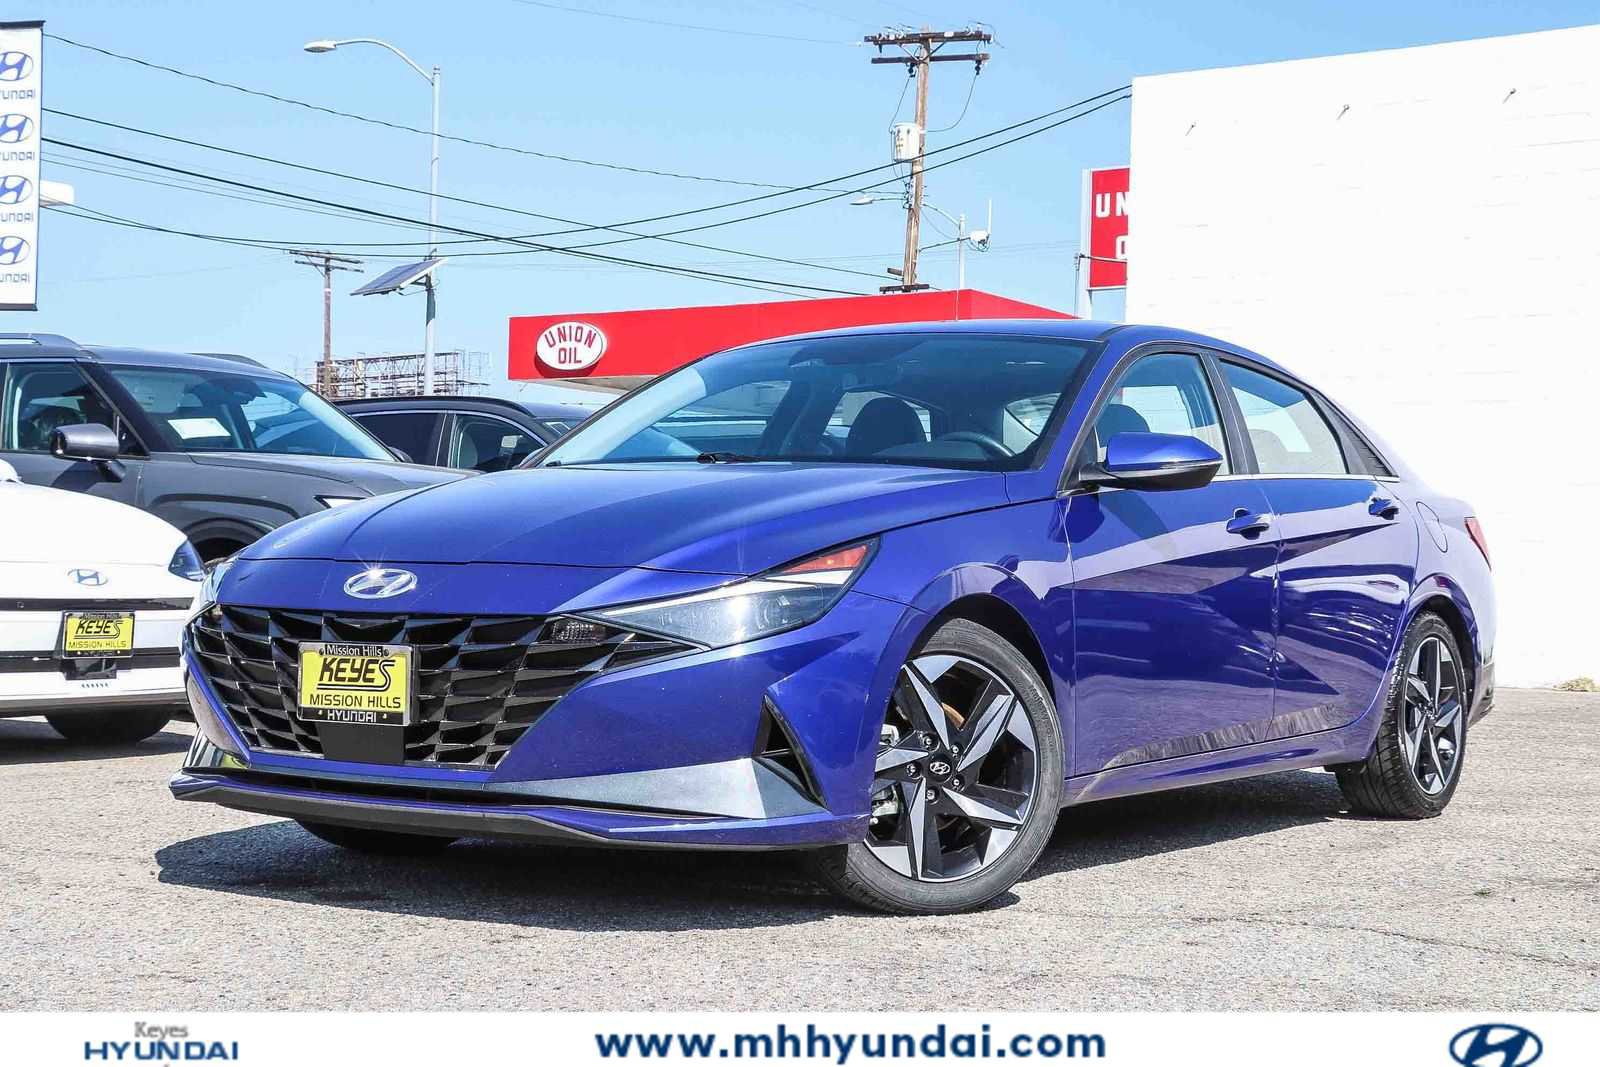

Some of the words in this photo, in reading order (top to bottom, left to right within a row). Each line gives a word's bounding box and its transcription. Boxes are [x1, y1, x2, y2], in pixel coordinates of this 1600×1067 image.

[0, 89, 35, 100] UNDAI
[544, 325, 597, 348] UNION
[558, 347, 582, 364] OIL
[74, 619, 124, 640] KEYES
[68, 640, 102, 649] MISSION
[105, 640, 127, 648] HILLS
[325, 645, 360, 656] Mission
[362, 645, 382, 657] Hills
[317, 657, 396, 691] KEYES
[309, 694, 362, 707] MISSION
[367, 696, 401, 709] HILLS
[327, 709, 377, 723] HYUNDAI
